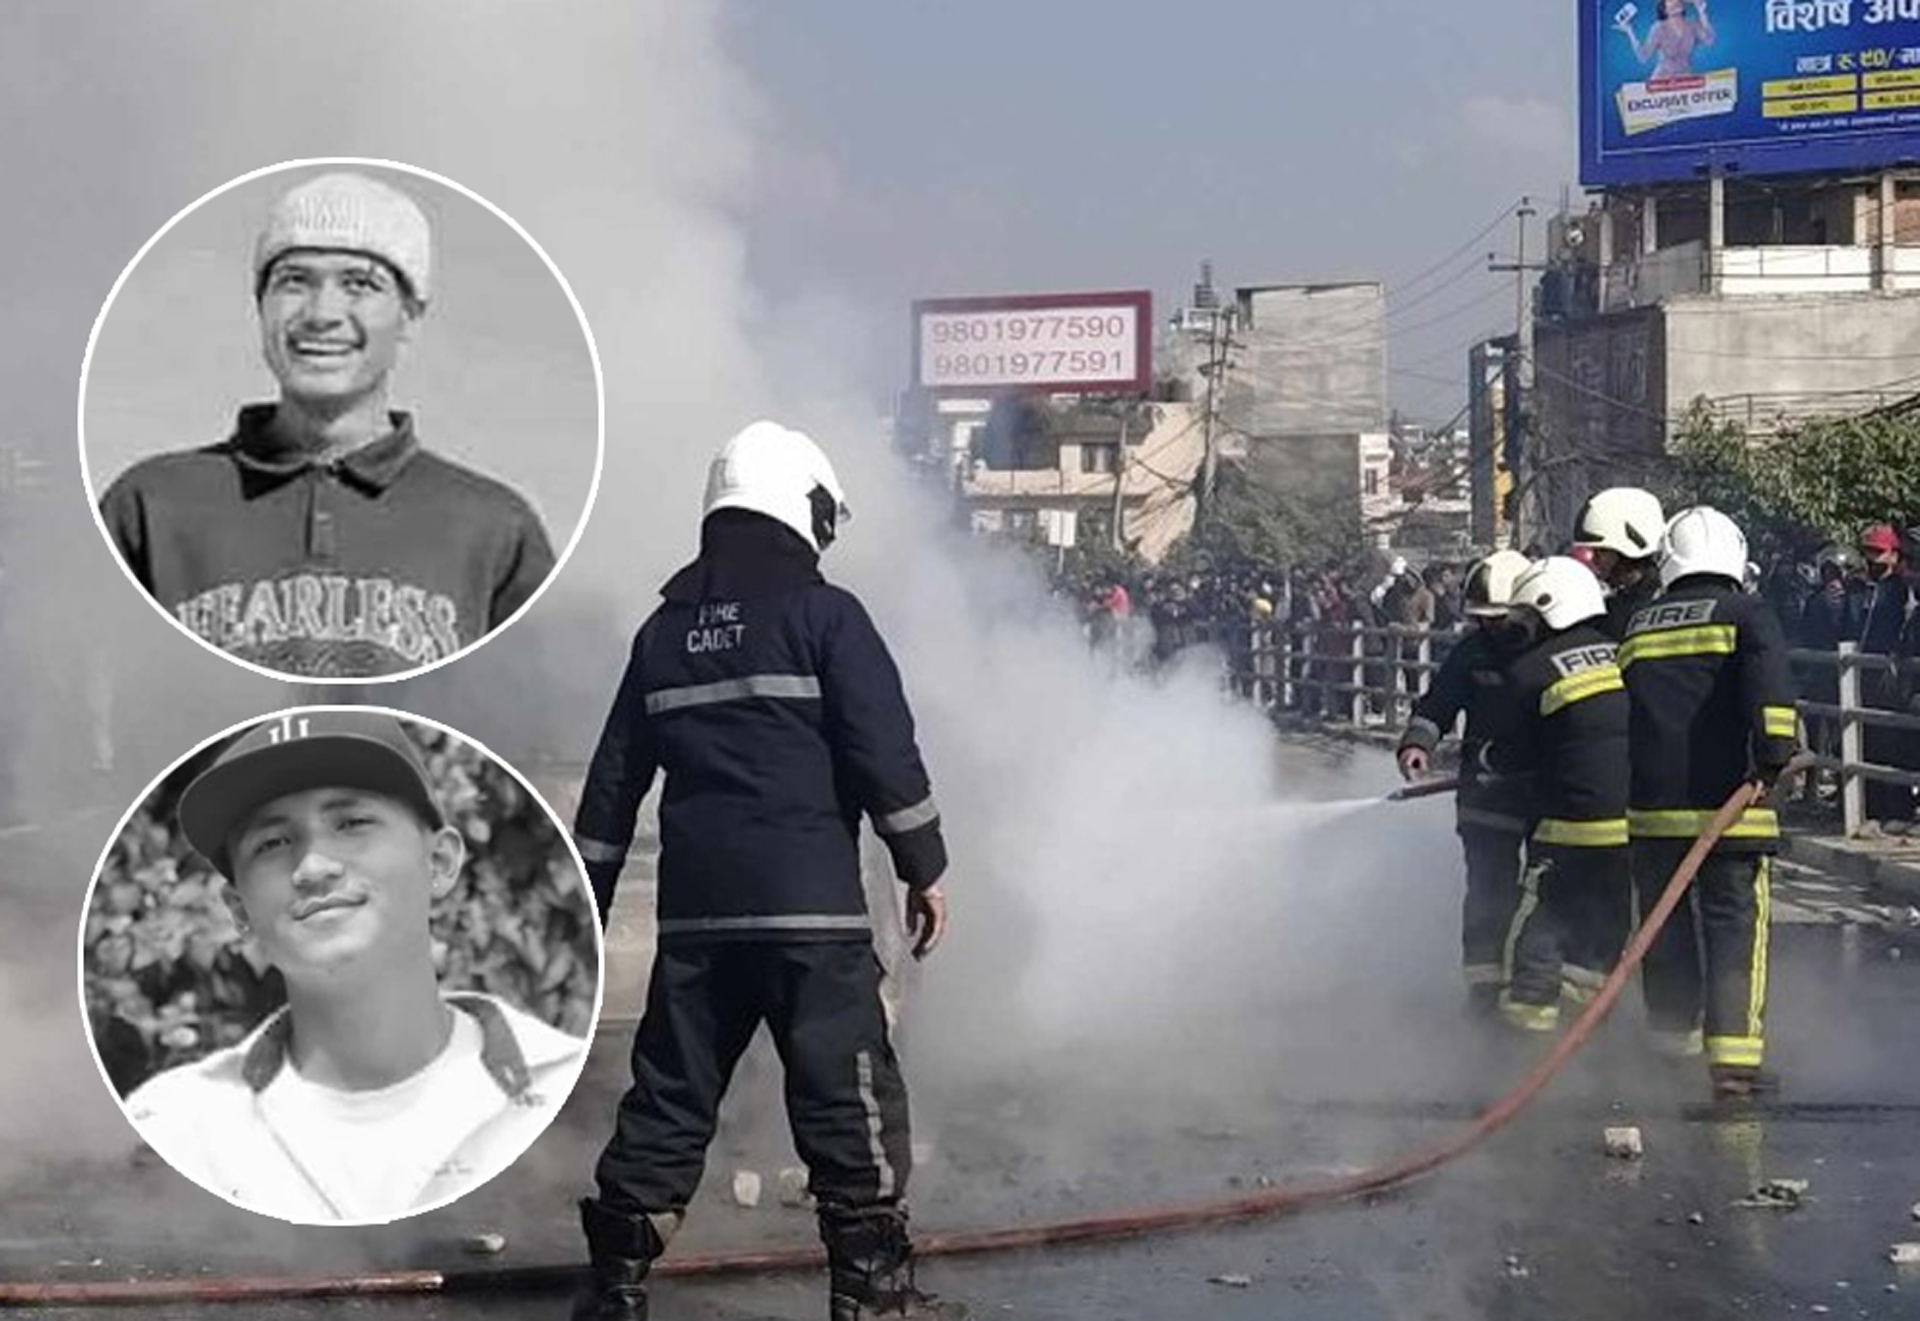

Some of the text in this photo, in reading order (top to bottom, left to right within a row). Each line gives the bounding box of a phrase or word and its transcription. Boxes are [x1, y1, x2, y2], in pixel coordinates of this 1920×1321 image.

[1628, 93, 1689, 113] EXCLUSIVE
[1691, 88, 1731, 104] OFFER
[932, 315, 1125, 344] 9801977590
[934, 350, 1122, 376] 9801977591
[1630, 604, 1706, 630] FIRE
[687, 623, 747, 653] CADET
[1559, 647, 1619, 673] FIR
